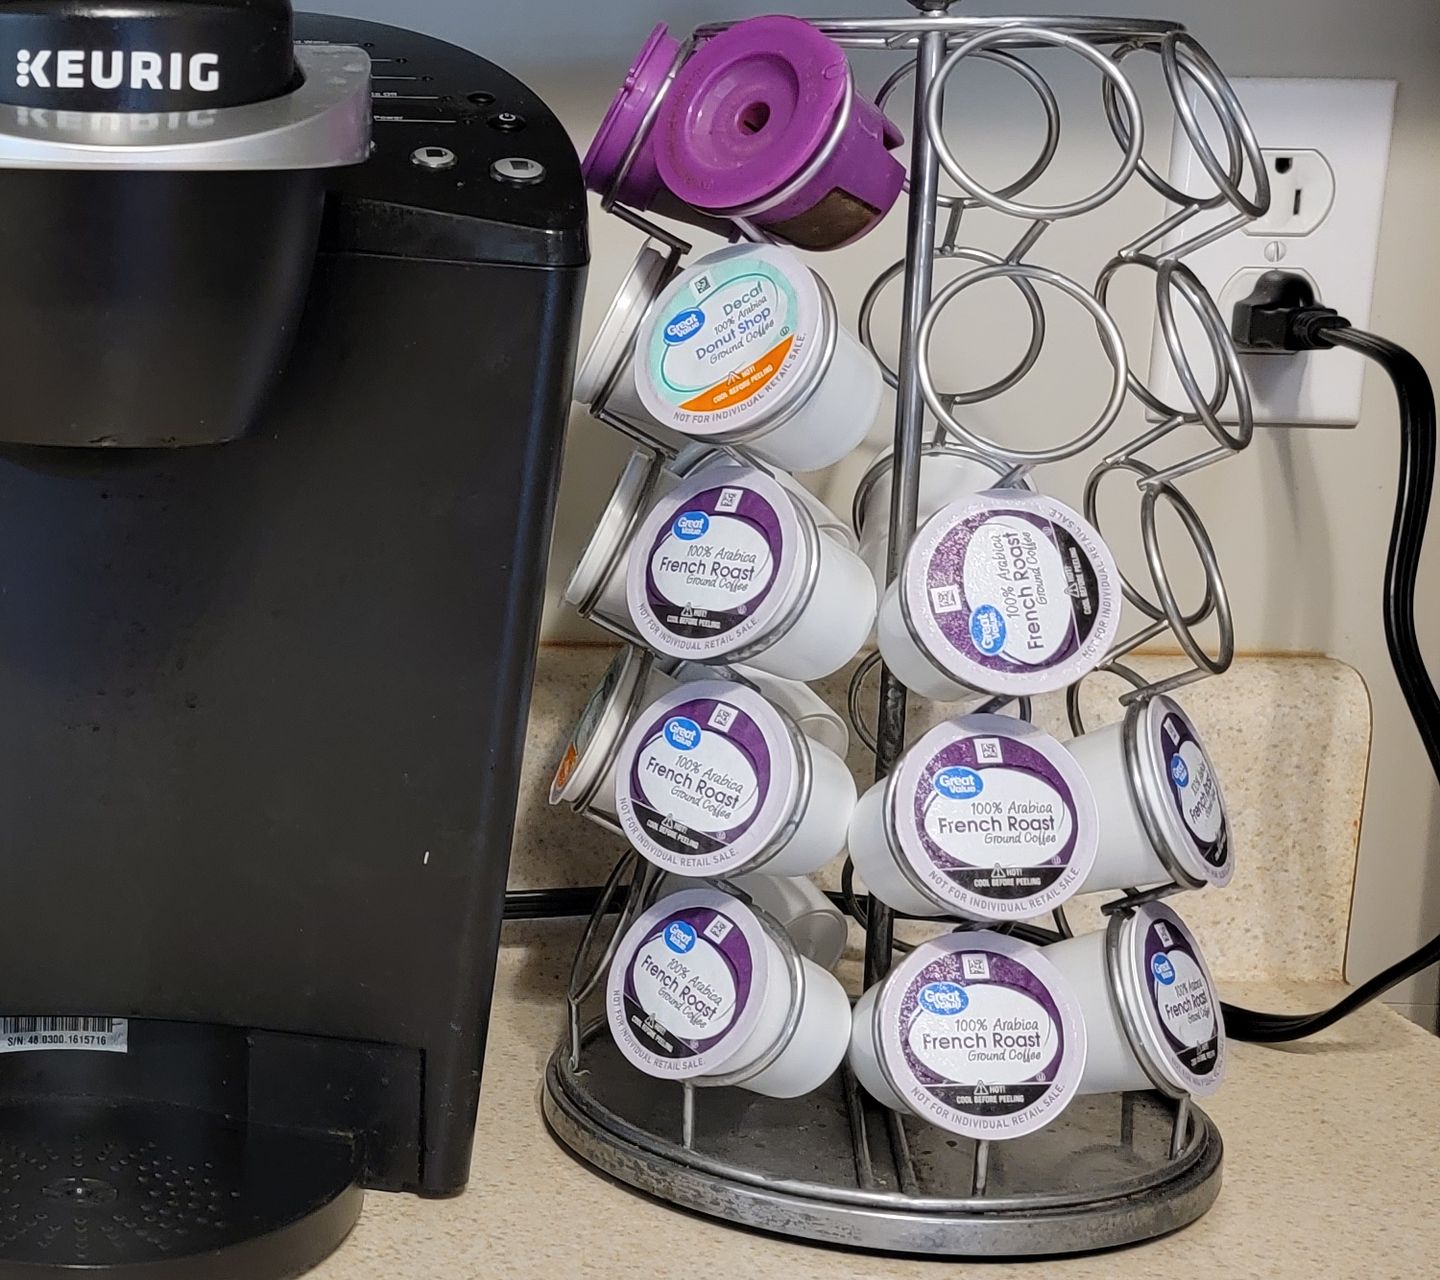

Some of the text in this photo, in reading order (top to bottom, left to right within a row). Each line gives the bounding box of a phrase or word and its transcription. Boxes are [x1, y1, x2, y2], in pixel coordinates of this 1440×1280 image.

[16, 49, 219, 92] KEURIG
[714, 295, 767, 334] 100% Arabica
[722, 281, 763, 316] Decaf
[667, 314, 698, 335] Great
[696, 308, 771, 361] Donut Shop
[710, 319, 775, 364] Ground Coffee
[673, 363, 792, 423] NOT FOR INDIVIDUAL RETAIL
[678, 518, 704, 529] Great
[687, 545, 757, 563] 100% Arabica
[1077, 526, 1100, 560] RETAIL
[660, 557, 755, 581] French Roast
[686, 575, 748, 592] Ground Coffee
[992, 534, 1019, 619] 100% Arabica
[1022, 532, 1047, 605] Ground Coffee
[1003, 532, 1044, 649] French Roast
[1099, 563, 1111, 618] INDIVIDUAL
[638, 603, 650, 619] NOT
[647, 619, 659, 635] FOR
[659, 630, 702, 650] INDIVIDUAL
[704, 635, 734, 649] RETAIL
[978, 614, 994, 648] Great
[1095, 622, 1108, 640] FOR
[669, 721, 696, 741] Great
[646, 757, 740, 809] French Roast
[675, 755, 744, 793] 100% Arabica
[939, 775, 975, 786] Great
[671, 785, 732, 819] Ground Coffee
[971, 801, 1053, 815] 100% Arabica
[619, 798, 629, 816] NOT
[625, 818, 638, 834] FOR
[636, 834, 678, 865] INDIVIDUAL
[680, 858, 710, 867] RETAIL
[938, 815, 1054, 833] French Roast
[985, 832, 1056, 845] Ground Coffee
[929, 871, 947, 888] NOT
[948, 886, 967, 902] FOR
[970, 897, 1027, 912] INDIVIDUAL
[1029, 889, 1060, 908] RETAIL
[641, 955, 717, 1020] French Roast
[658, 987, 681, 1011] Ground
[667, 958, 722, 1006] 100% Arabica
[924, 991, 960, 1002] Great
[614, 1009, 624, 1026] FOR
[620, 1026, 652, 1063] INDIVIDUAL
[653, 1058, 680, 1070] RETAIL
[923, 1033, 1041, 1050] French Roast
[955, 1019, 1039, 1032] 100% Arabica
[968, 1049, 1041, 1063] Ground Coffee
[911, 1087, 929, 1105] NOT
[930, 1102, 949, 1118] FOR
[951, 1114, 1010, 1129] INDIVIDUAL
[1012, 1106, 1044, 1125] RETAIL
